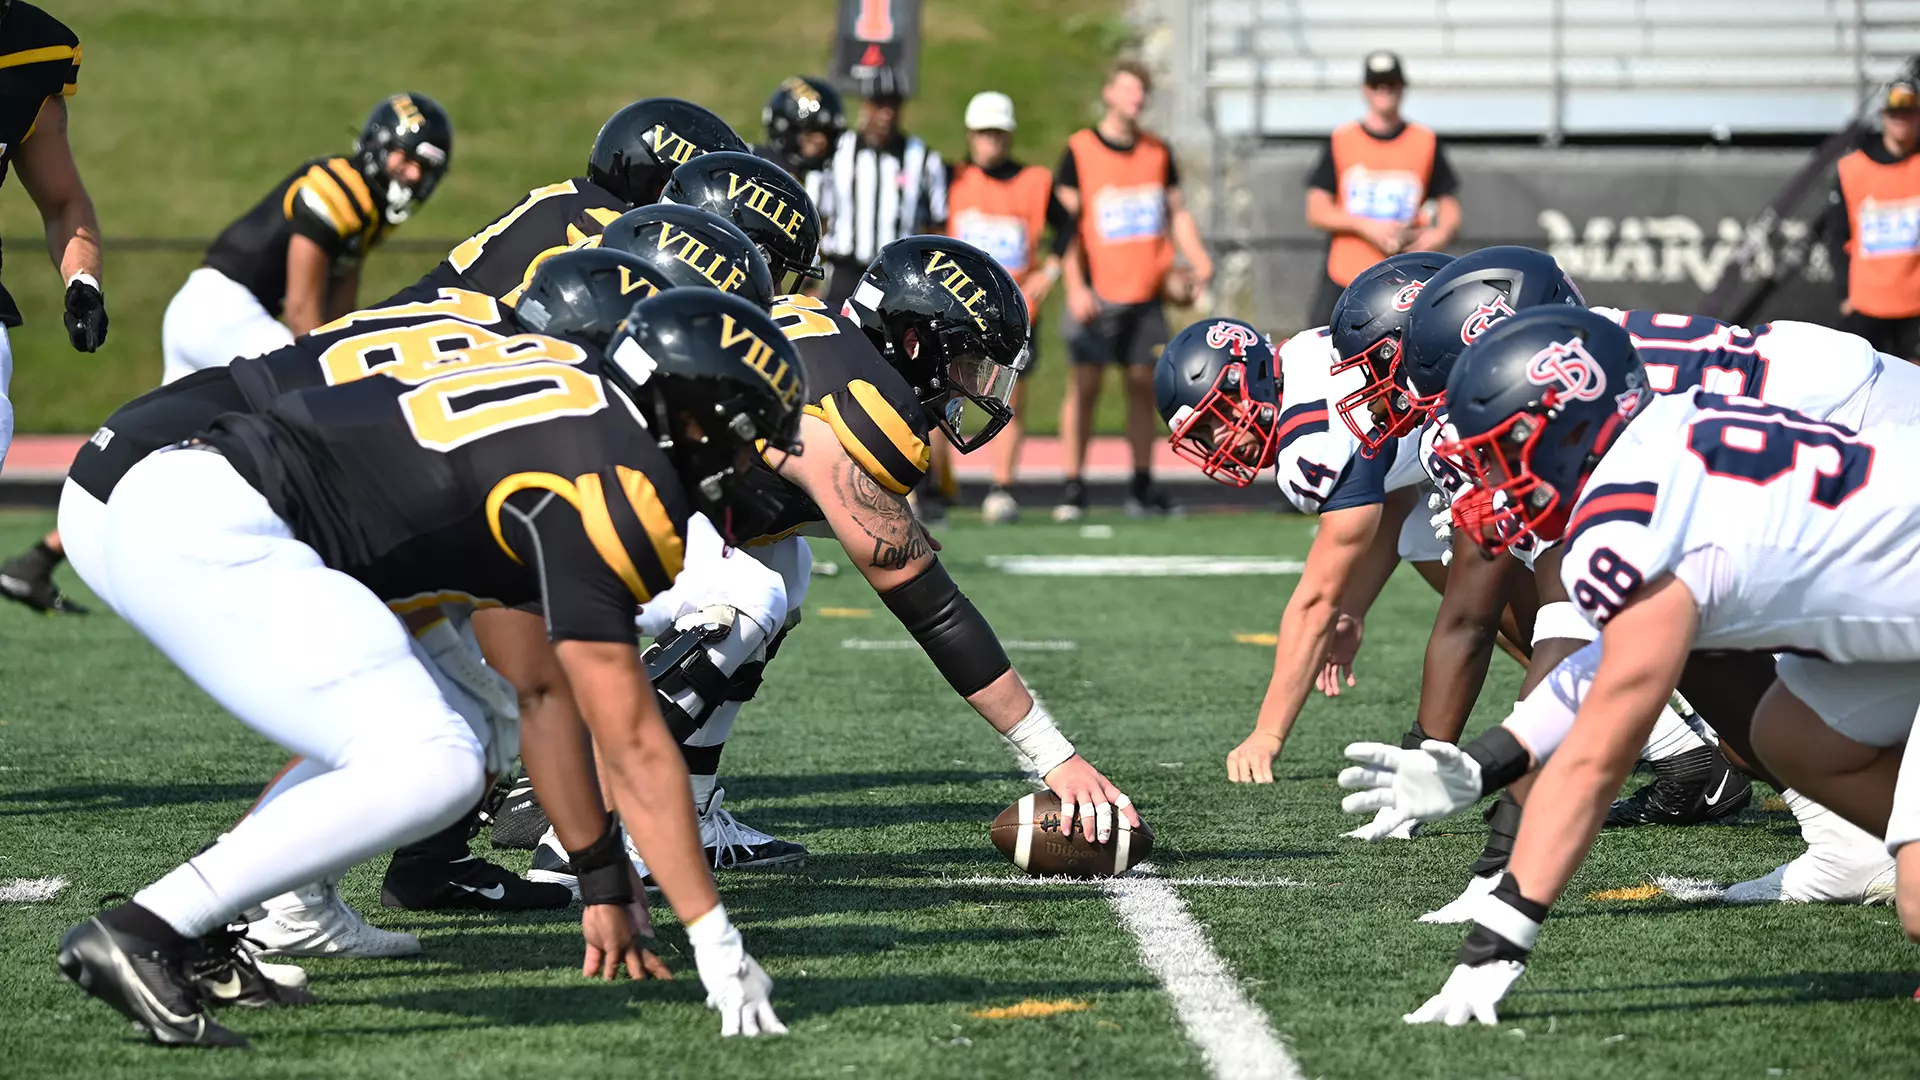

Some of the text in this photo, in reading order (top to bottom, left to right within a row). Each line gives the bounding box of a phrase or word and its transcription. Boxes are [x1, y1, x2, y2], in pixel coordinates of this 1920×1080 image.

[726, 172, 806, 241] VILLE
[924, 250, 988, 331] VILL
[398, 333, 609, 453] 80
[1288, 455, 1338, 506] 14
[1573, 546, 1645, 627] 98
